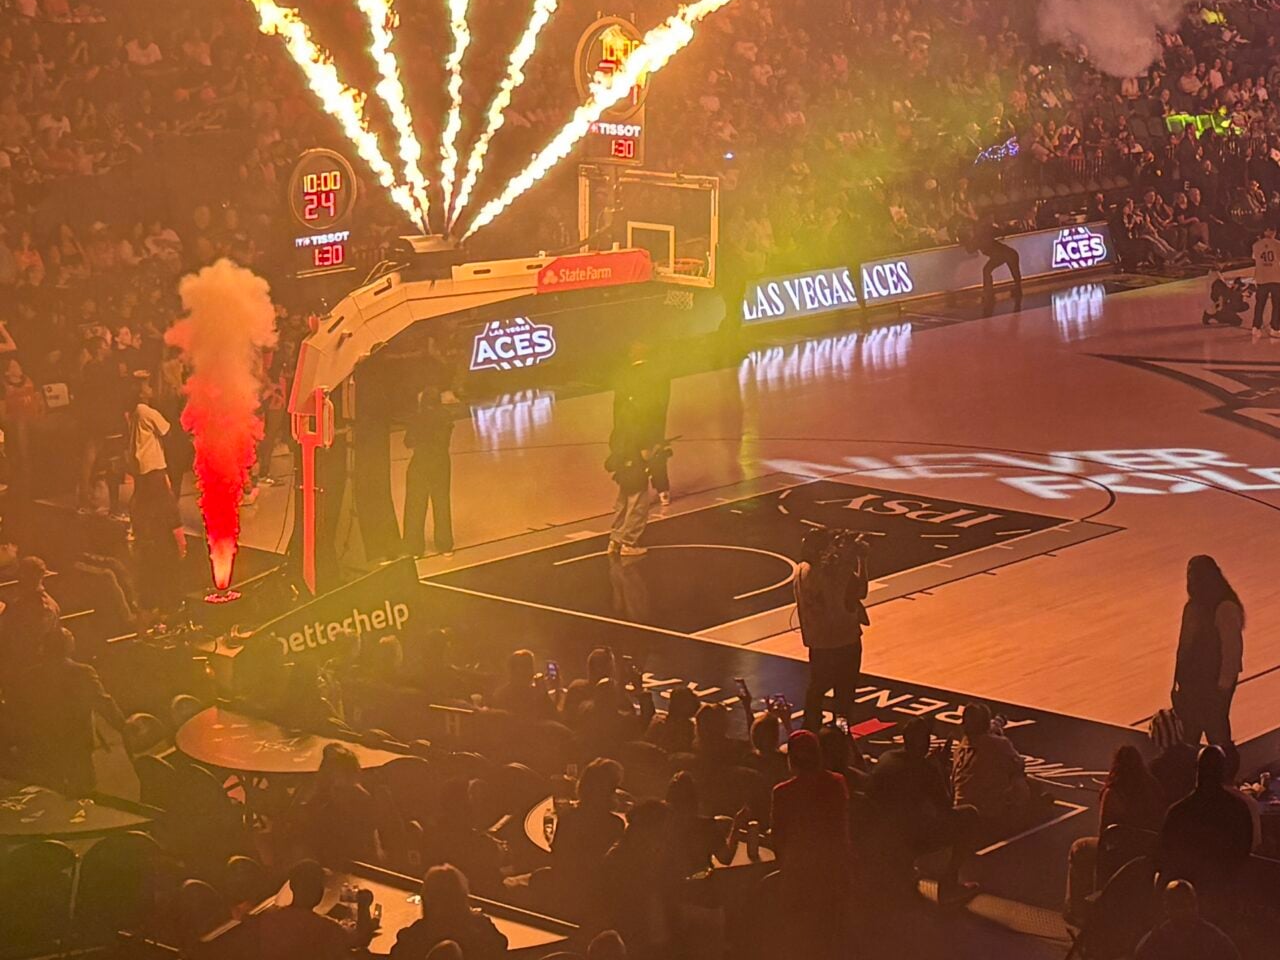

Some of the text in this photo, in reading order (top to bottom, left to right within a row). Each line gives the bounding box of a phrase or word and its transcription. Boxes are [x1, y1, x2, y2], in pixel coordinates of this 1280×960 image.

[599, 123, 641, 138] TISSOT
[611, 139, 634, 158] 1:30
[303, 171, 341, 194] 10:00
[304, 192, 334, 220] 24
[309, 231, 350, 246] TISSOT
[1056, 237, 1104, 263] ACES
[314, 244, 343, 266] 1:30
[1260, 250, 1274, 263] 40
[742, 261, 913, 320] LAS VEGAS ACES
[477, 330, 552, 363] ACES
[762, 446, 1250, 481] NEVER
[815, 493, 1004, 529] IPSY
